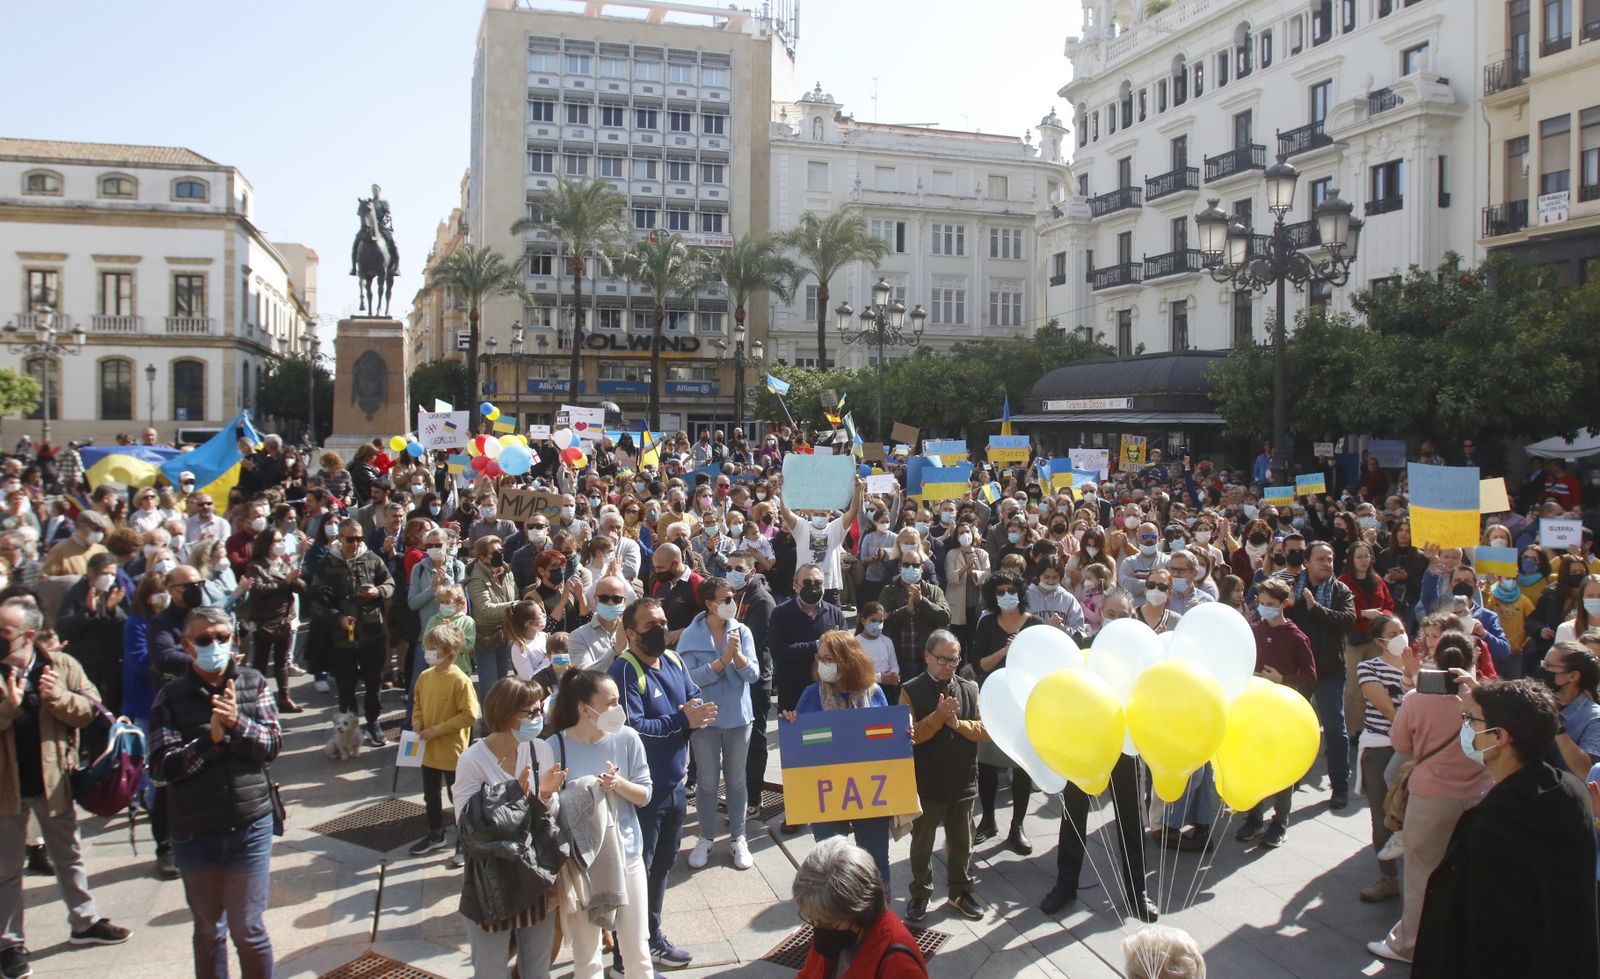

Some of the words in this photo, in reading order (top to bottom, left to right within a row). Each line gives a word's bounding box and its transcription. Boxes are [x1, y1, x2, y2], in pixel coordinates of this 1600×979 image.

[677, 384, 700, 392] Allianz
[1123, 434, 1144, 447] STOP
[500, 493, 548, 517] МИР
[817, 774, 888, 813] PAZ
